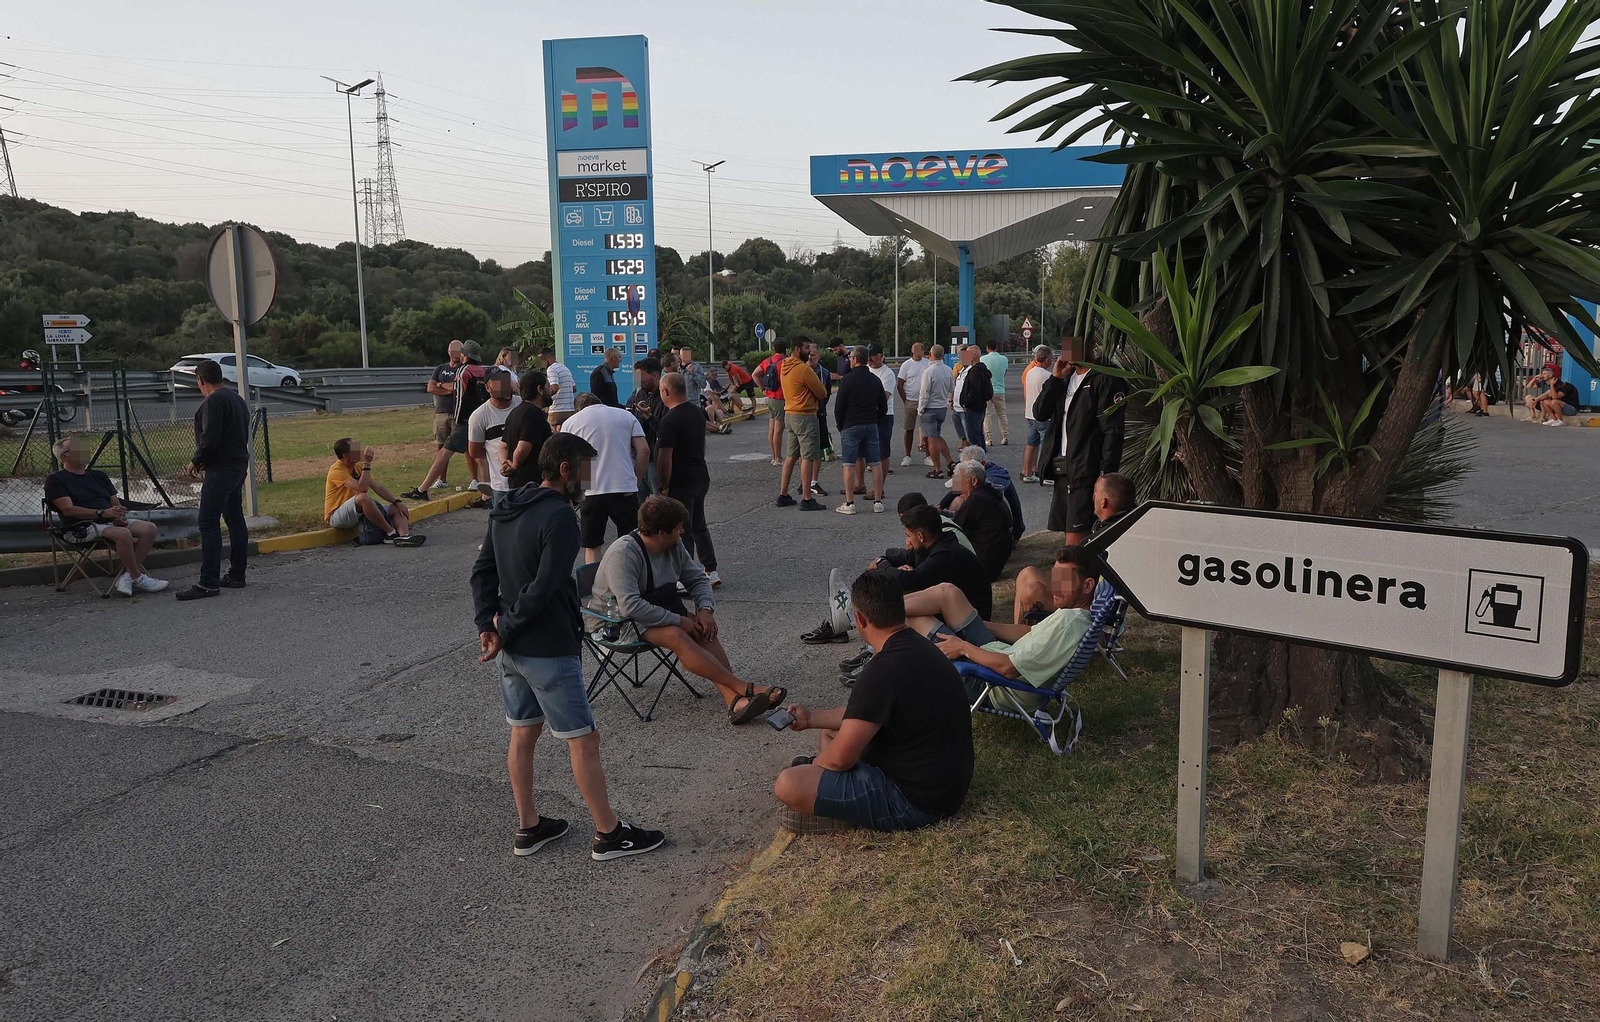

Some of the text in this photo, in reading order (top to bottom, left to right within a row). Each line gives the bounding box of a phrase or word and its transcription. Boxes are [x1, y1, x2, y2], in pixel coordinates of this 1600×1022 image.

[577, 159, 627, 173] market
[839, 153, 1009, 190] moeve
[575, 182, 631, 198] R'SPIRO
[572, 233, 644, 249] Diesel 1.539
[573, 259, 645, 275] 95 1.529
[574, 285, 646, 301] Diesel 1.59
[575, 313, 588, 323] 95
[1177, 553, 1427, 610] gasolinera
